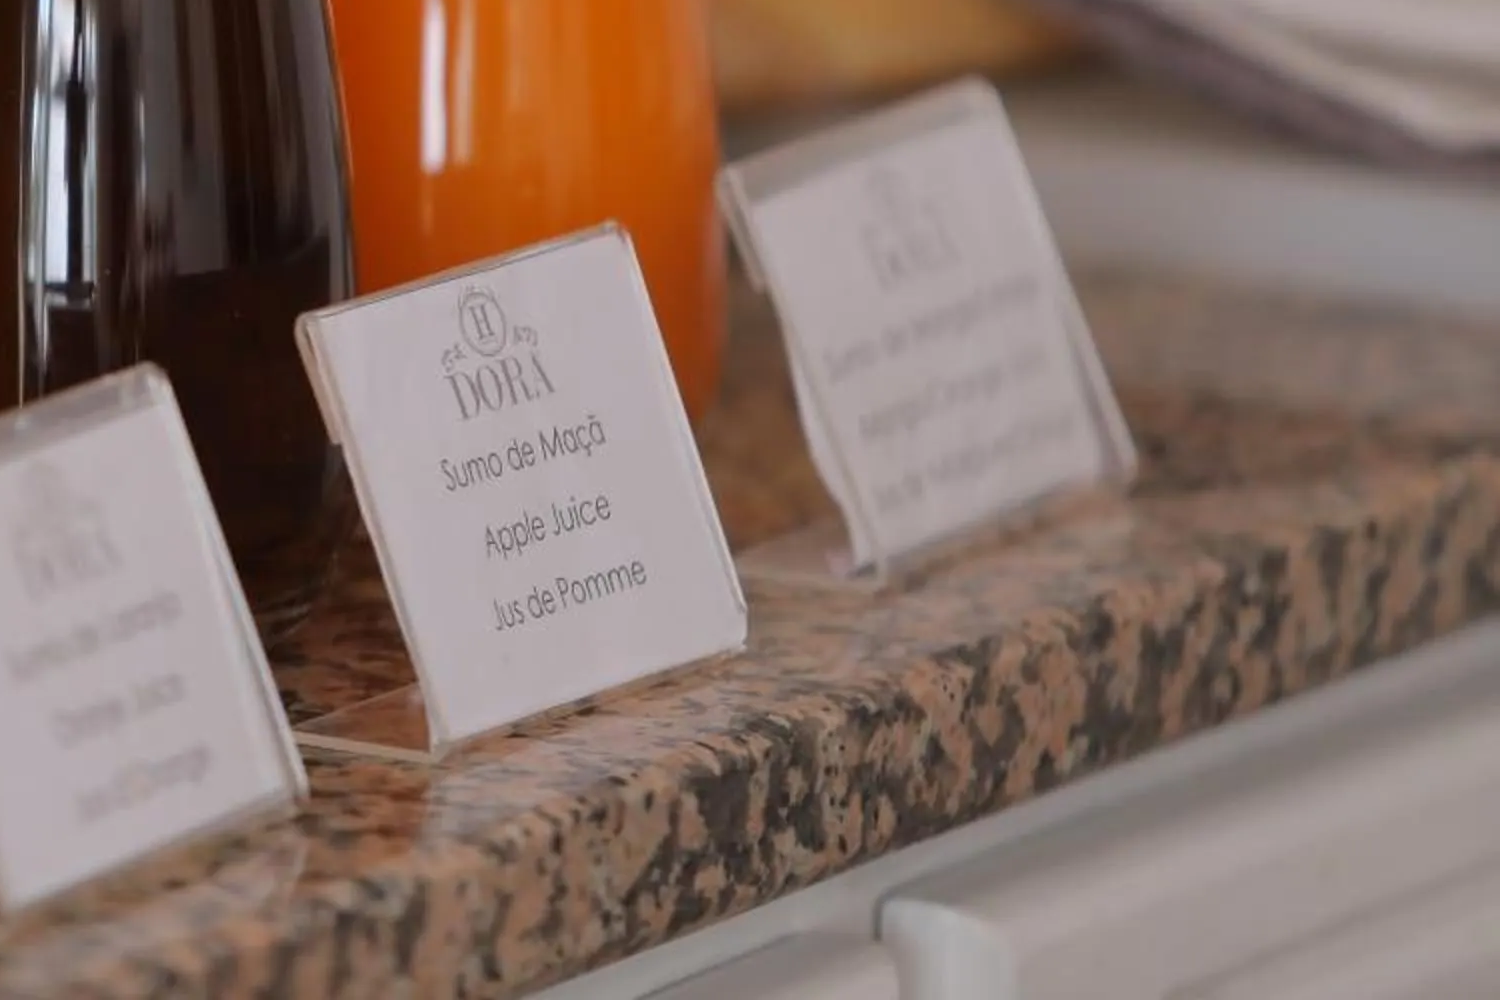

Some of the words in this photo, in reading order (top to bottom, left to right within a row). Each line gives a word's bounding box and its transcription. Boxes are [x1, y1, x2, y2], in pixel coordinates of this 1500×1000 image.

[468, 302, 497, 340] H
[443, 352, 556, 420] DORA
[440, 452, 503, 491] Sumo
[507, 438, 536, 471] de
[538, 415, 607, 457] Maçã
[484, 509, 546, 560] Apple
[551, 495, 611, 536] Juice
[493, 598, 525, 631] Jus
[527, 585, 556, 618] de
[555, 560, 648, 609] Pomme
